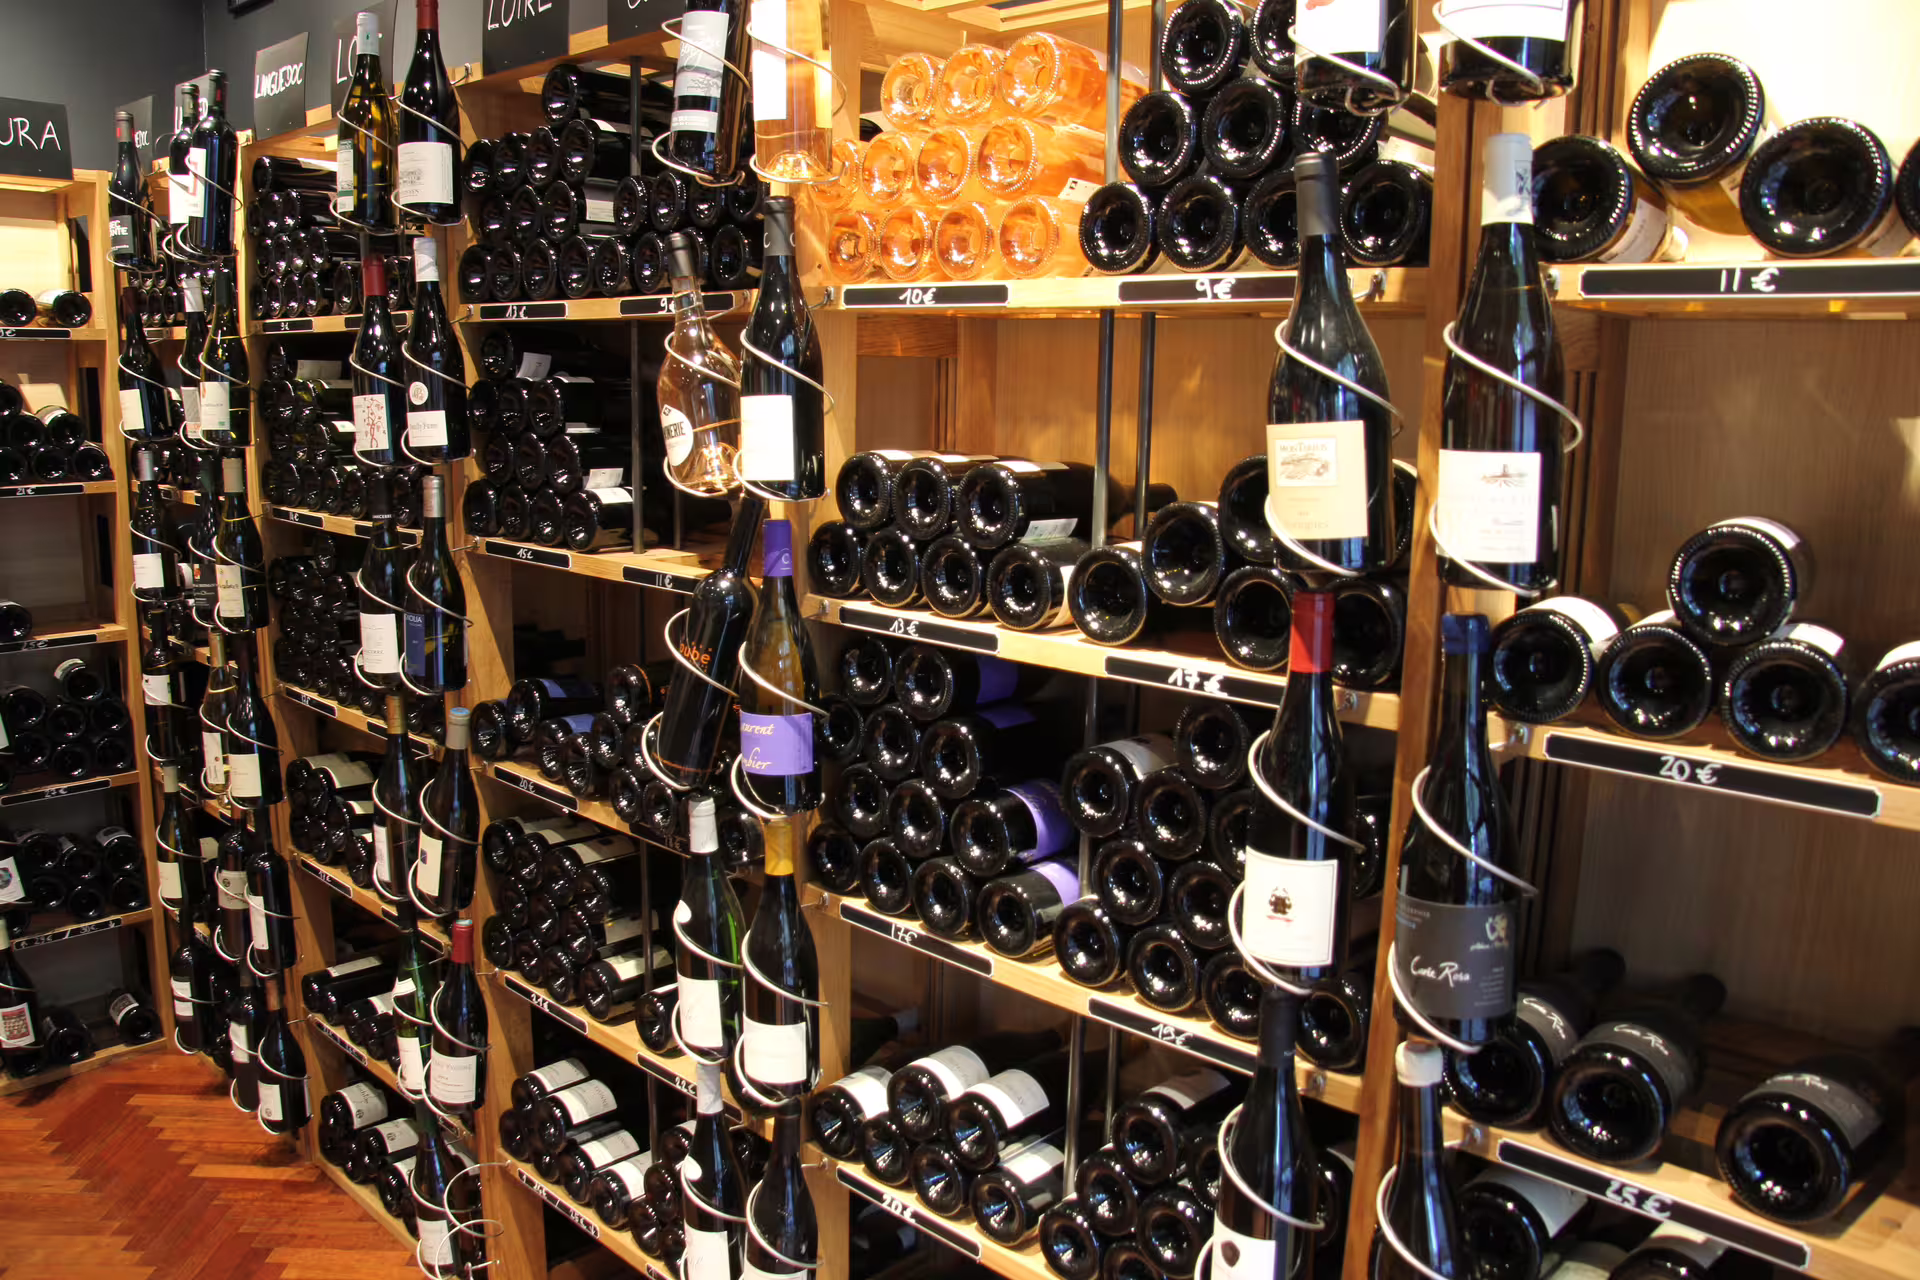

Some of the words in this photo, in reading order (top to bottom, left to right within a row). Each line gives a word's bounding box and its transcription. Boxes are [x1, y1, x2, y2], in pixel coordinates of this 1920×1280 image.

[254, 62, 303, 99] LANGUEDOC
[899, 287, 936, 304] 10€
[1195, 278, 1235, 300] 9€
[889, 618, 920, 637] 13€
[1168, 667, 1228, 697] 17€
[891, 923, 918, 945] 17€
[1152, 1023, 1193, 1047] 19€
